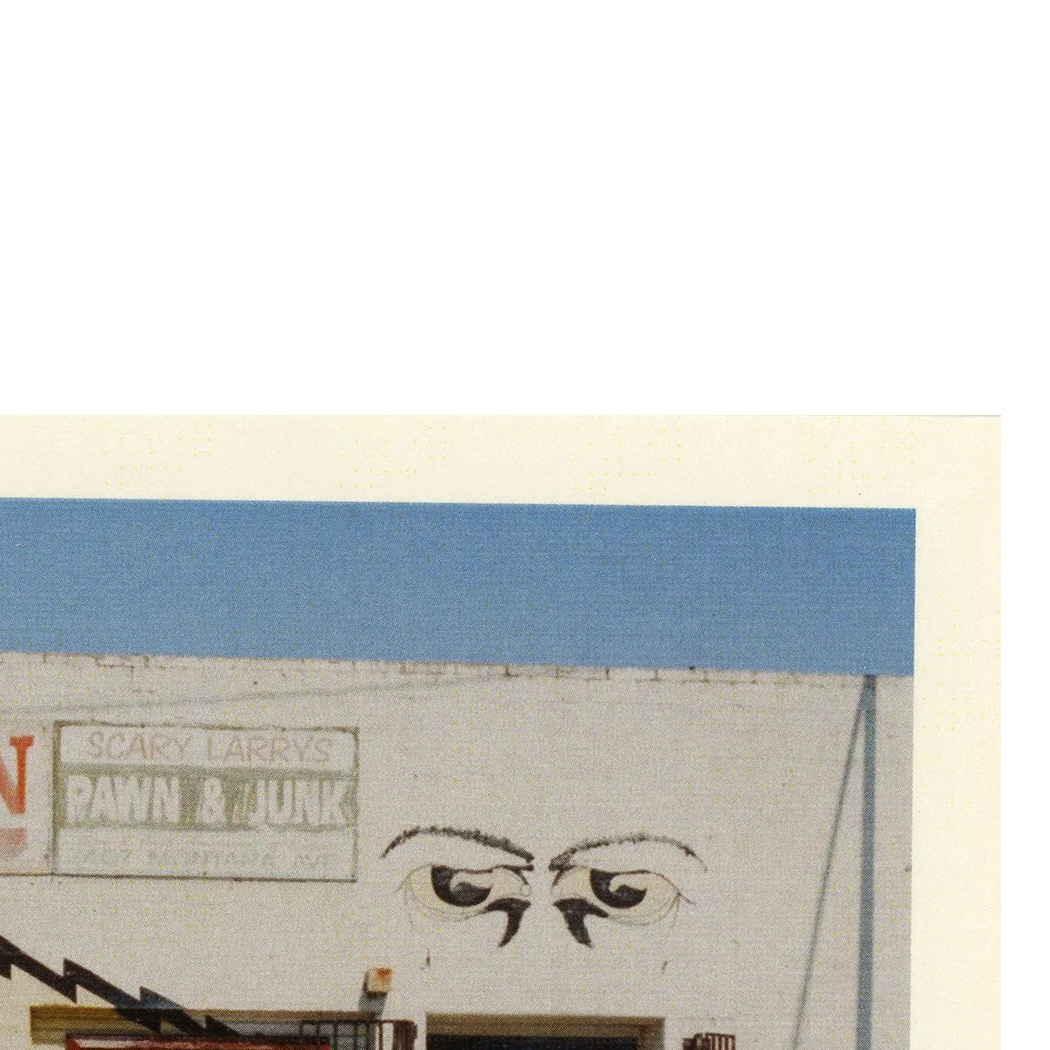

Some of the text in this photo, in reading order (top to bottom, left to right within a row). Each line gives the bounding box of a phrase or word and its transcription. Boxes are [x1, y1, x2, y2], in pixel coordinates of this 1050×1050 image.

[87, 731, 334, 763] SCARY LARRYS
[65, 774, 352, 826] PAWN & JUNK
